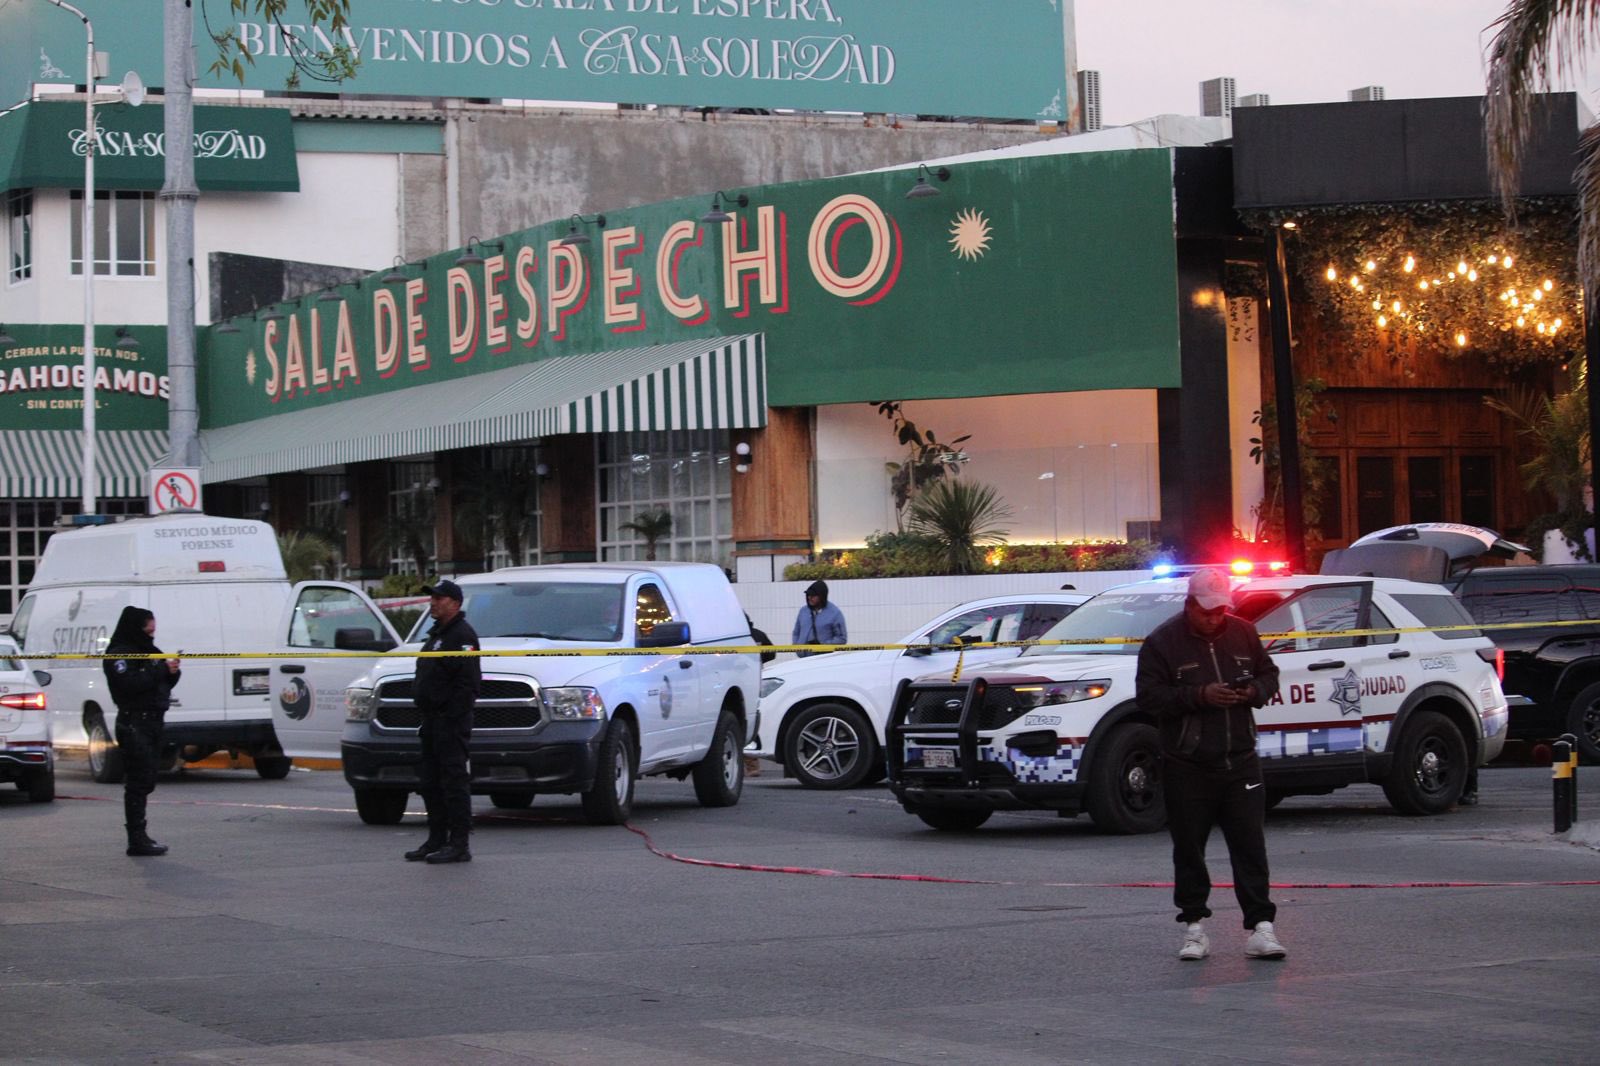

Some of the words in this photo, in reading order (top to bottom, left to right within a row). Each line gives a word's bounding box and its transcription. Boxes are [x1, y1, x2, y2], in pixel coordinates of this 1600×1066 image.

[239, 22, 531, 68] BIENVENIDOS
[541, 36, 569, 69] A
[143, 129, 266, 159] SOEDAD
[264, 300, 359, 400] SALA
[374, 278, 429, 376] DE
[447, 194, 900, 360] DESPECHO
[5, 346, 49, 359] CERRAR
[53, 346, 67, 355] LA
[70, 346, 113, 357] PURTA
[115, 349, 138, 361] NOS
[27, 400, 47, 409] SIN
[50, 400, 102, 410] CONTRL
[154, 527, 209, 538] SERVICIO
[181, 539, 234, 550] FORENSE
[1290, 683, 1316, 704] DE
